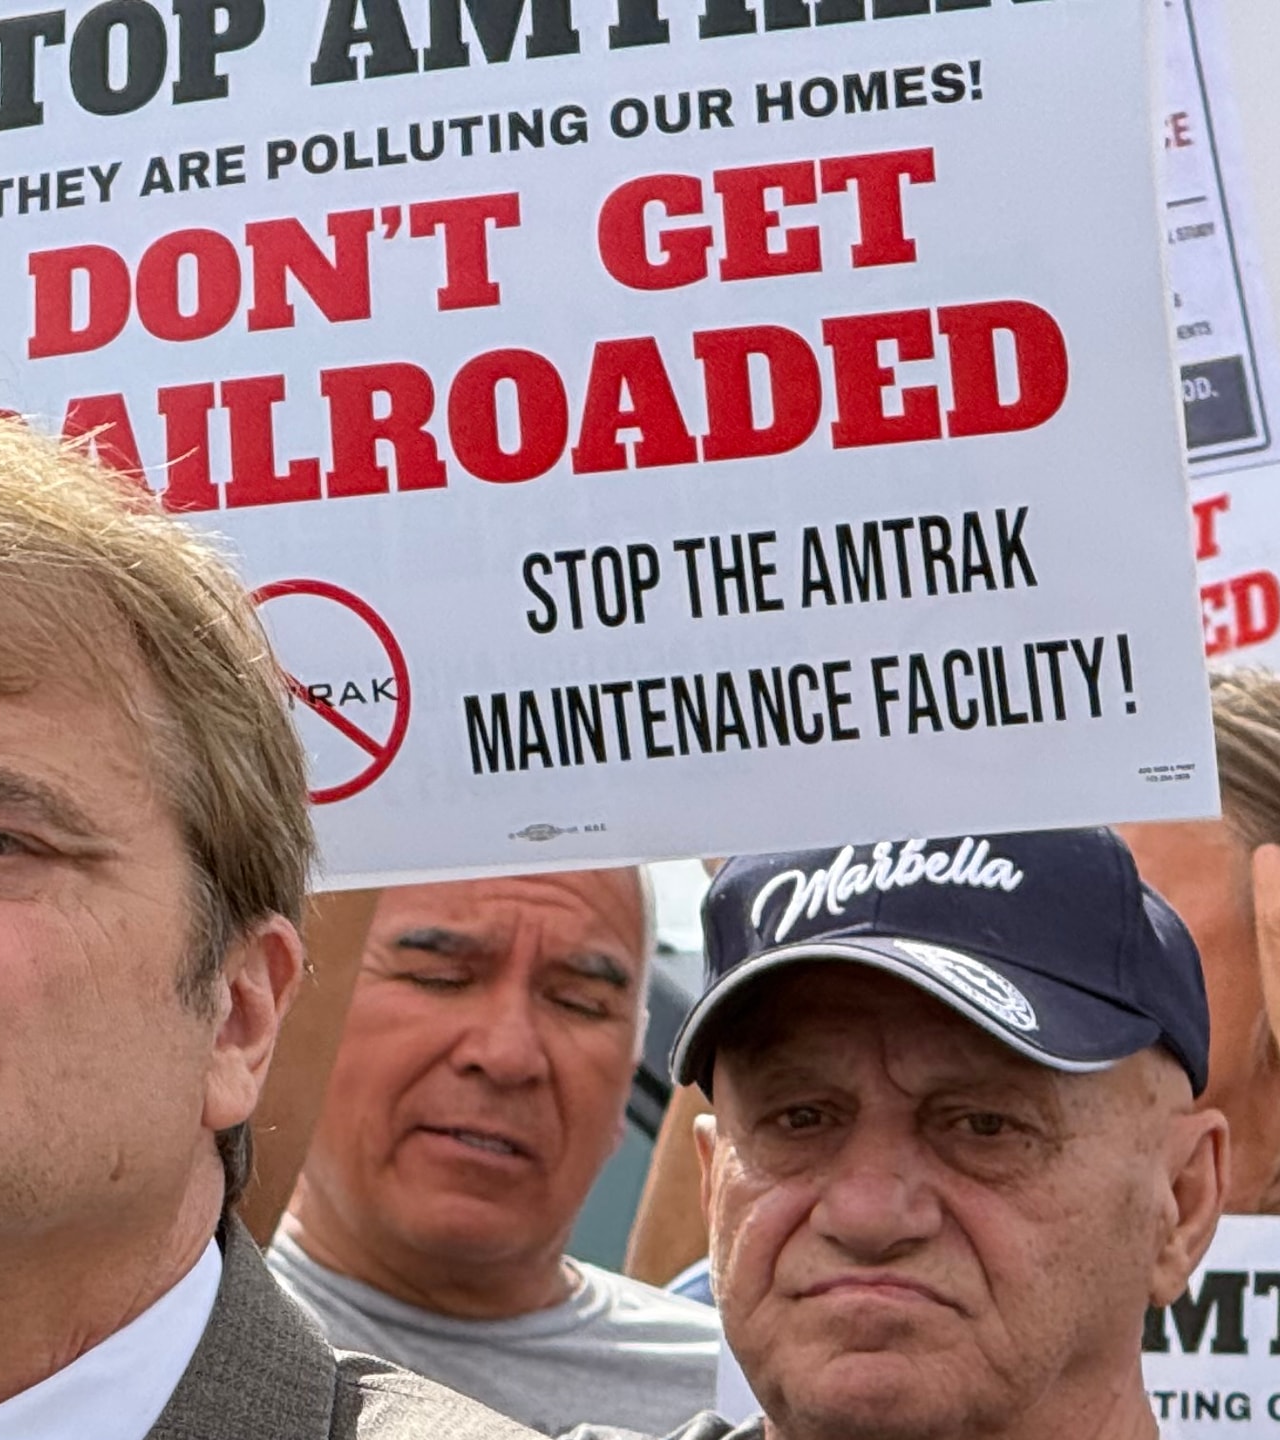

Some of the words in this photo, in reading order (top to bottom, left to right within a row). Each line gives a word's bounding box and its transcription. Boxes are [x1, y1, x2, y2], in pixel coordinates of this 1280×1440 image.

[140, 144, 246, 197] ARE
[266, 103, 588, 180] POLLUTING
[610, 88, 734, 139] OUR
[756, 60, 984, 124] HOMES!
[28, 191, 520, 360] DON'T
[597, 147, 936, 291] GET
[523, 543, 660, 634] STOP
[673, 530, 785, 619] THE
[802, 506, 1038, 608] AMTRAK
[464, 660, 860, 774] MAINTENANCE
[871, 633, 1137, 737] FACILITY!
[751, 836, 1023, 943] Marbella
